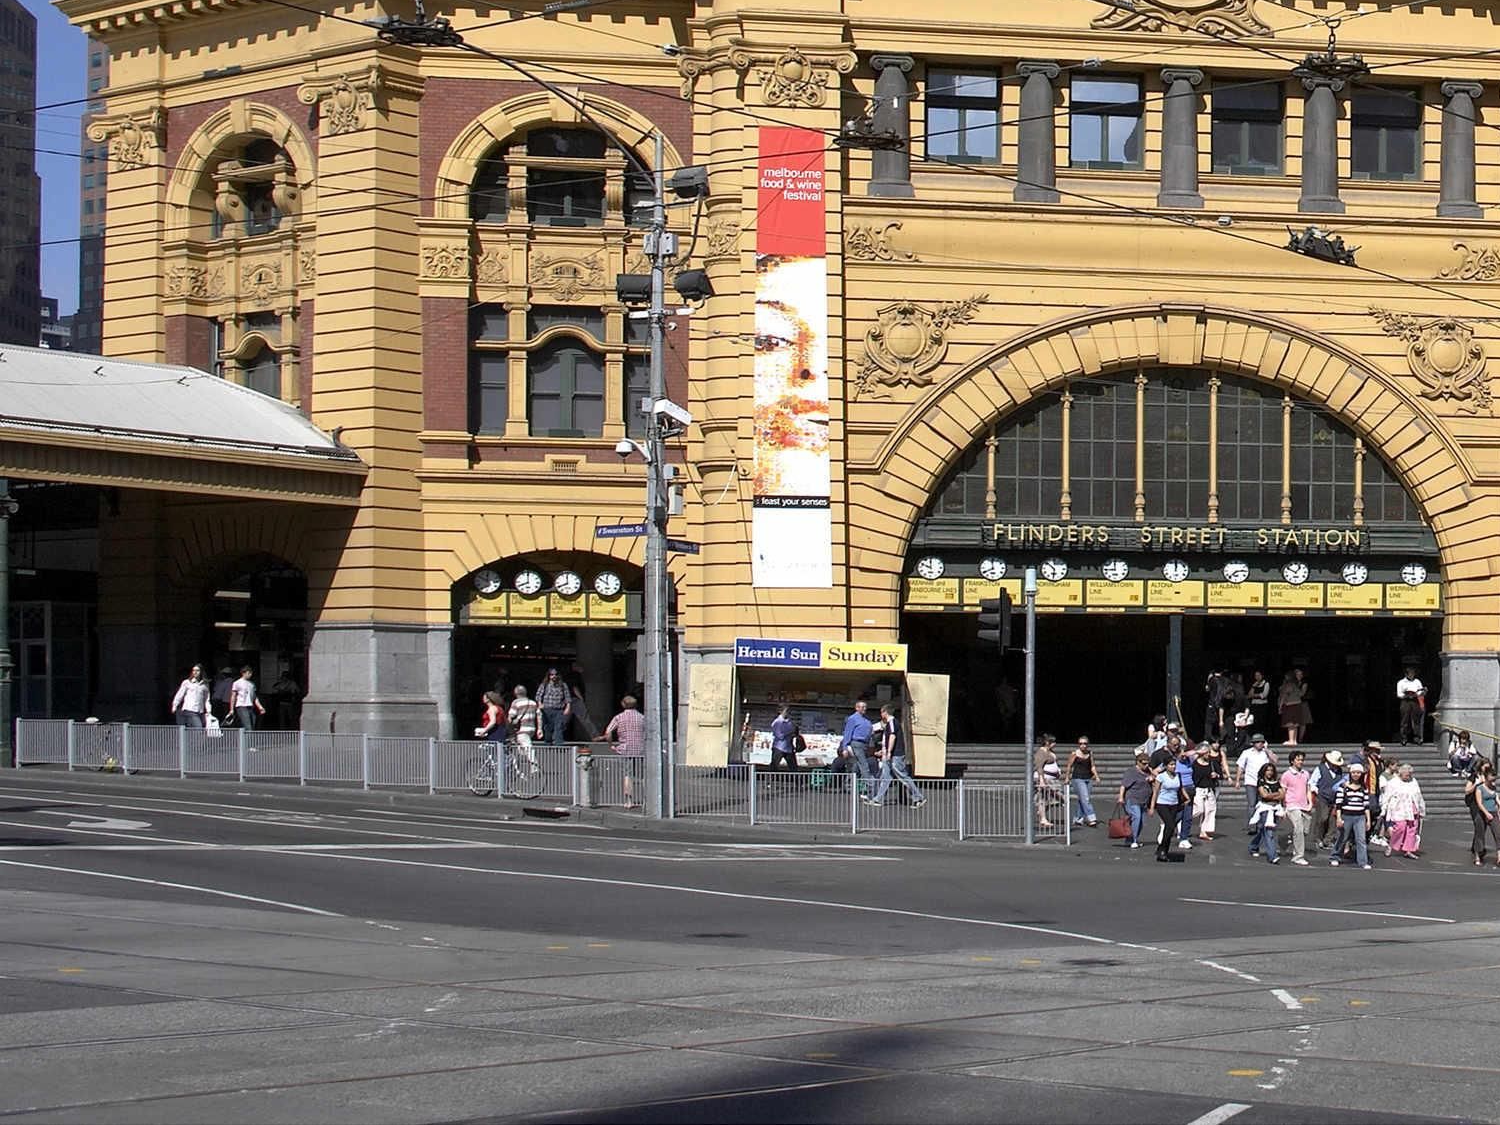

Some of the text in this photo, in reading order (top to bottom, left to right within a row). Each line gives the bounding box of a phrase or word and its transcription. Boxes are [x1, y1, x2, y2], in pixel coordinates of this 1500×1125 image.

[764, 167, 822, 179] melbourne
[760, 177, 822, 190] food & wine
[783, 189, 822, 202] festival
[761, 497, 780, 505] feast
[782, 498, 800, 507] your
[602, 525, 643, 535] Swanston St
[993, 523, 1361, 546] FLINDERS STREET STATION
[737, 645, 819, 661] Herald Sun
[828, 647, 900, 666] Sunday
